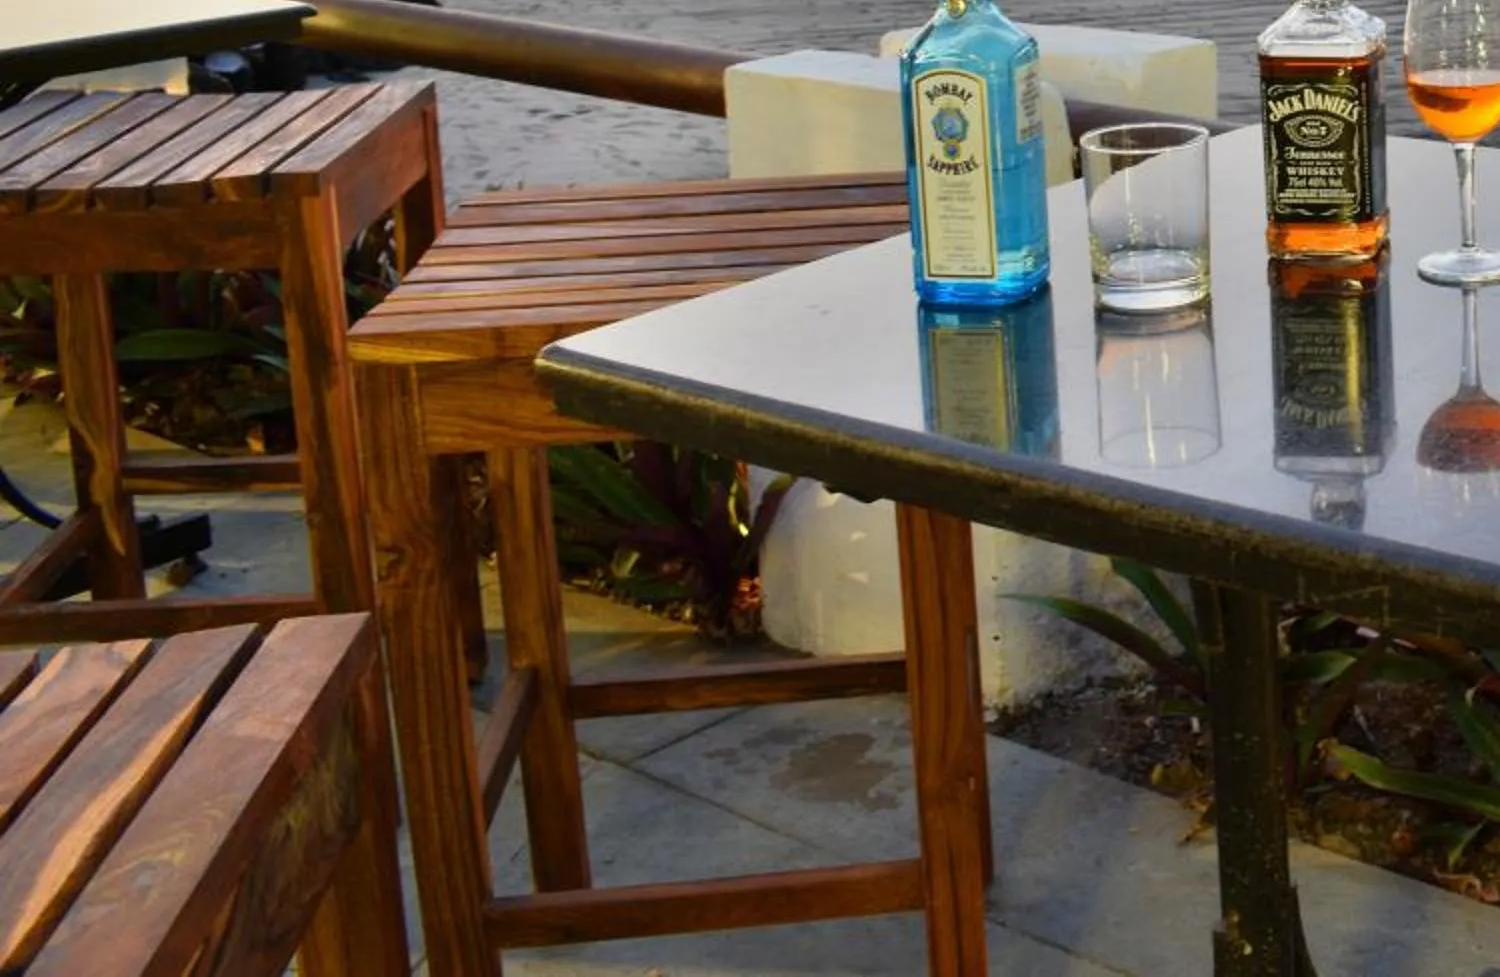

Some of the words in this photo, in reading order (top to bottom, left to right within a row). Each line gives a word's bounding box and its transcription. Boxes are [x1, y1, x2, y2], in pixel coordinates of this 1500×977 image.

[925, 83, 973, 105] BOMBAY
[1268, 94, 1303, 122] JACK
[928, 152, 979, 175] SAPPHIRE
